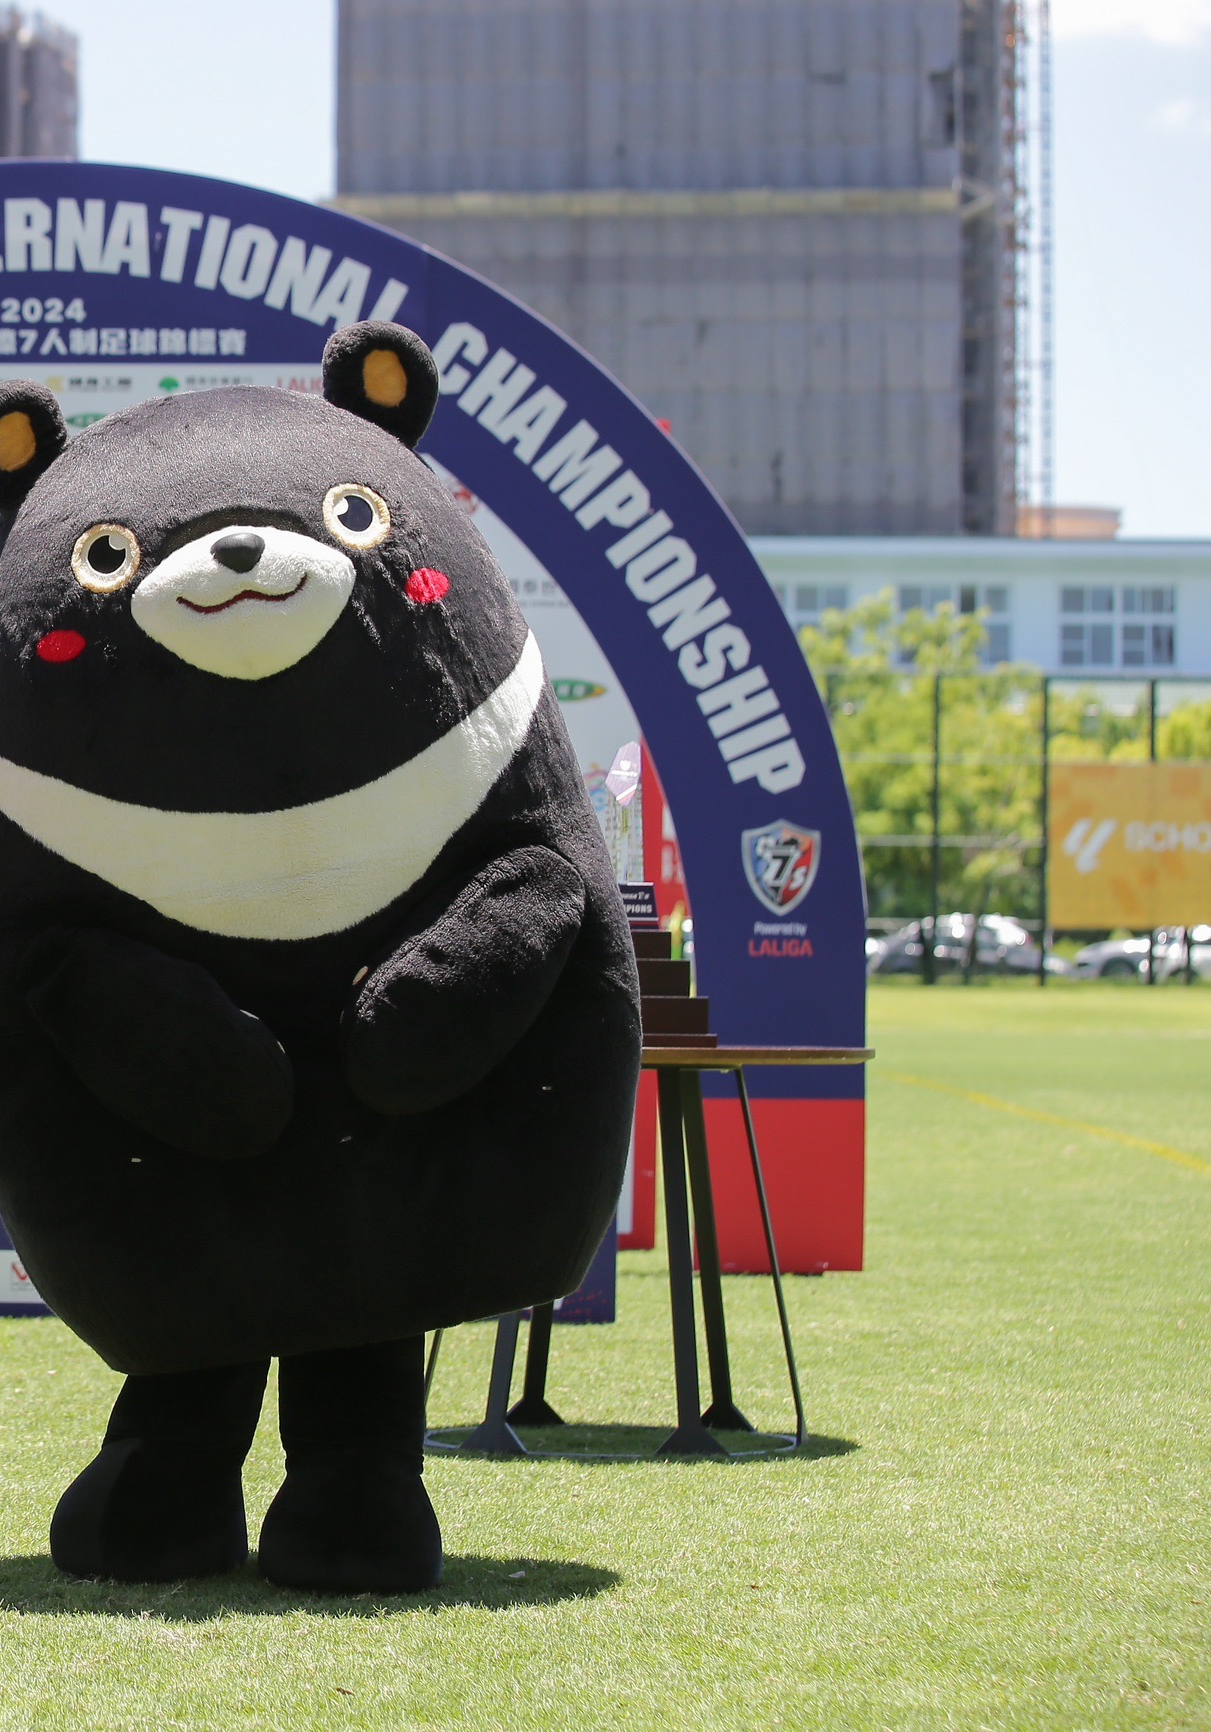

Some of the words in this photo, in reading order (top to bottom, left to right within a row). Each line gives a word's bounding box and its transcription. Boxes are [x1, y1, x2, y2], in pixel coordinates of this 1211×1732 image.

[1, 297, 87, 324] 2024
[431, 321, 806, 795] CHAMPIONSHIP
[749, 939, 813, 957] LALIGA
